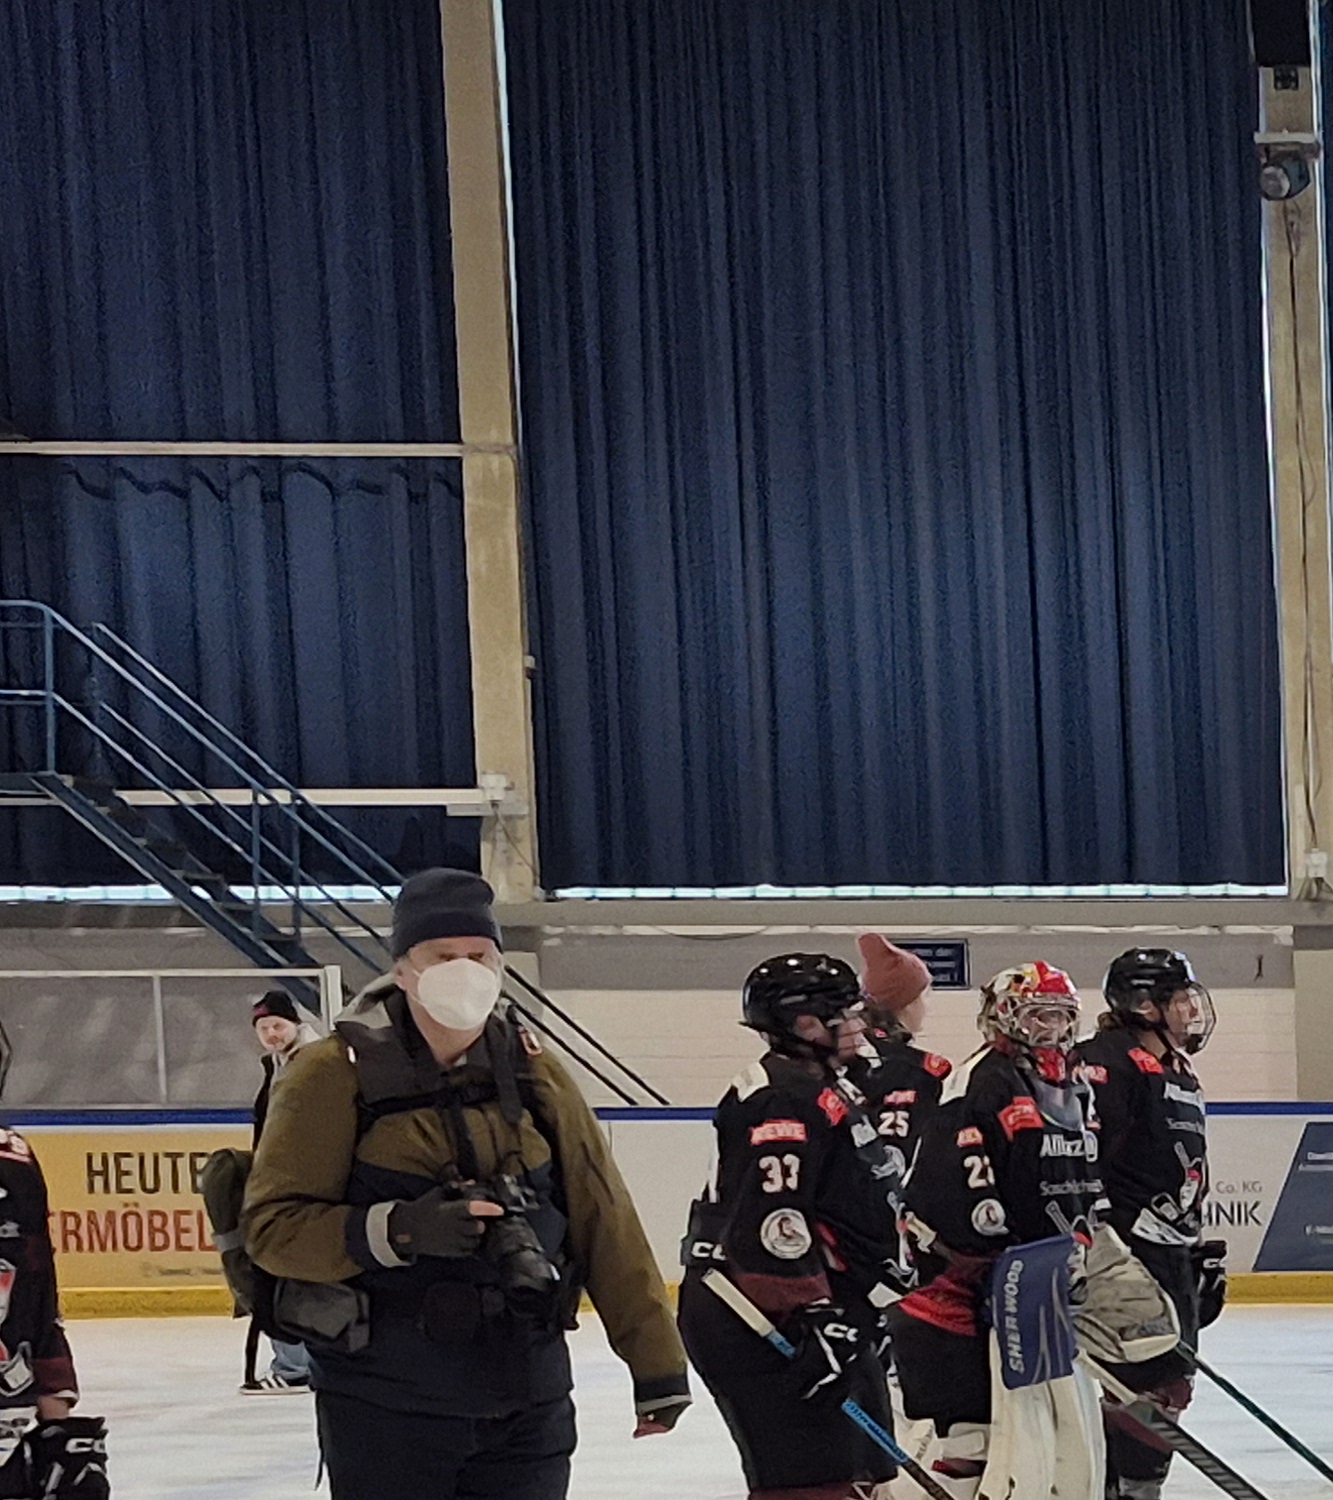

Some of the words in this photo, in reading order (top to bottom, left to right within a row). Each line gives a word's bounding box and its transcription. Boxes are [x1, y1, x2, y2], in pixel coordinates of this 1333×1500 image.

[878, 1110, 910, 1137] 25
[86, 1152, 209, 1194] HEUTE
[49, 1202, 221, 1254] RMÖBEL
